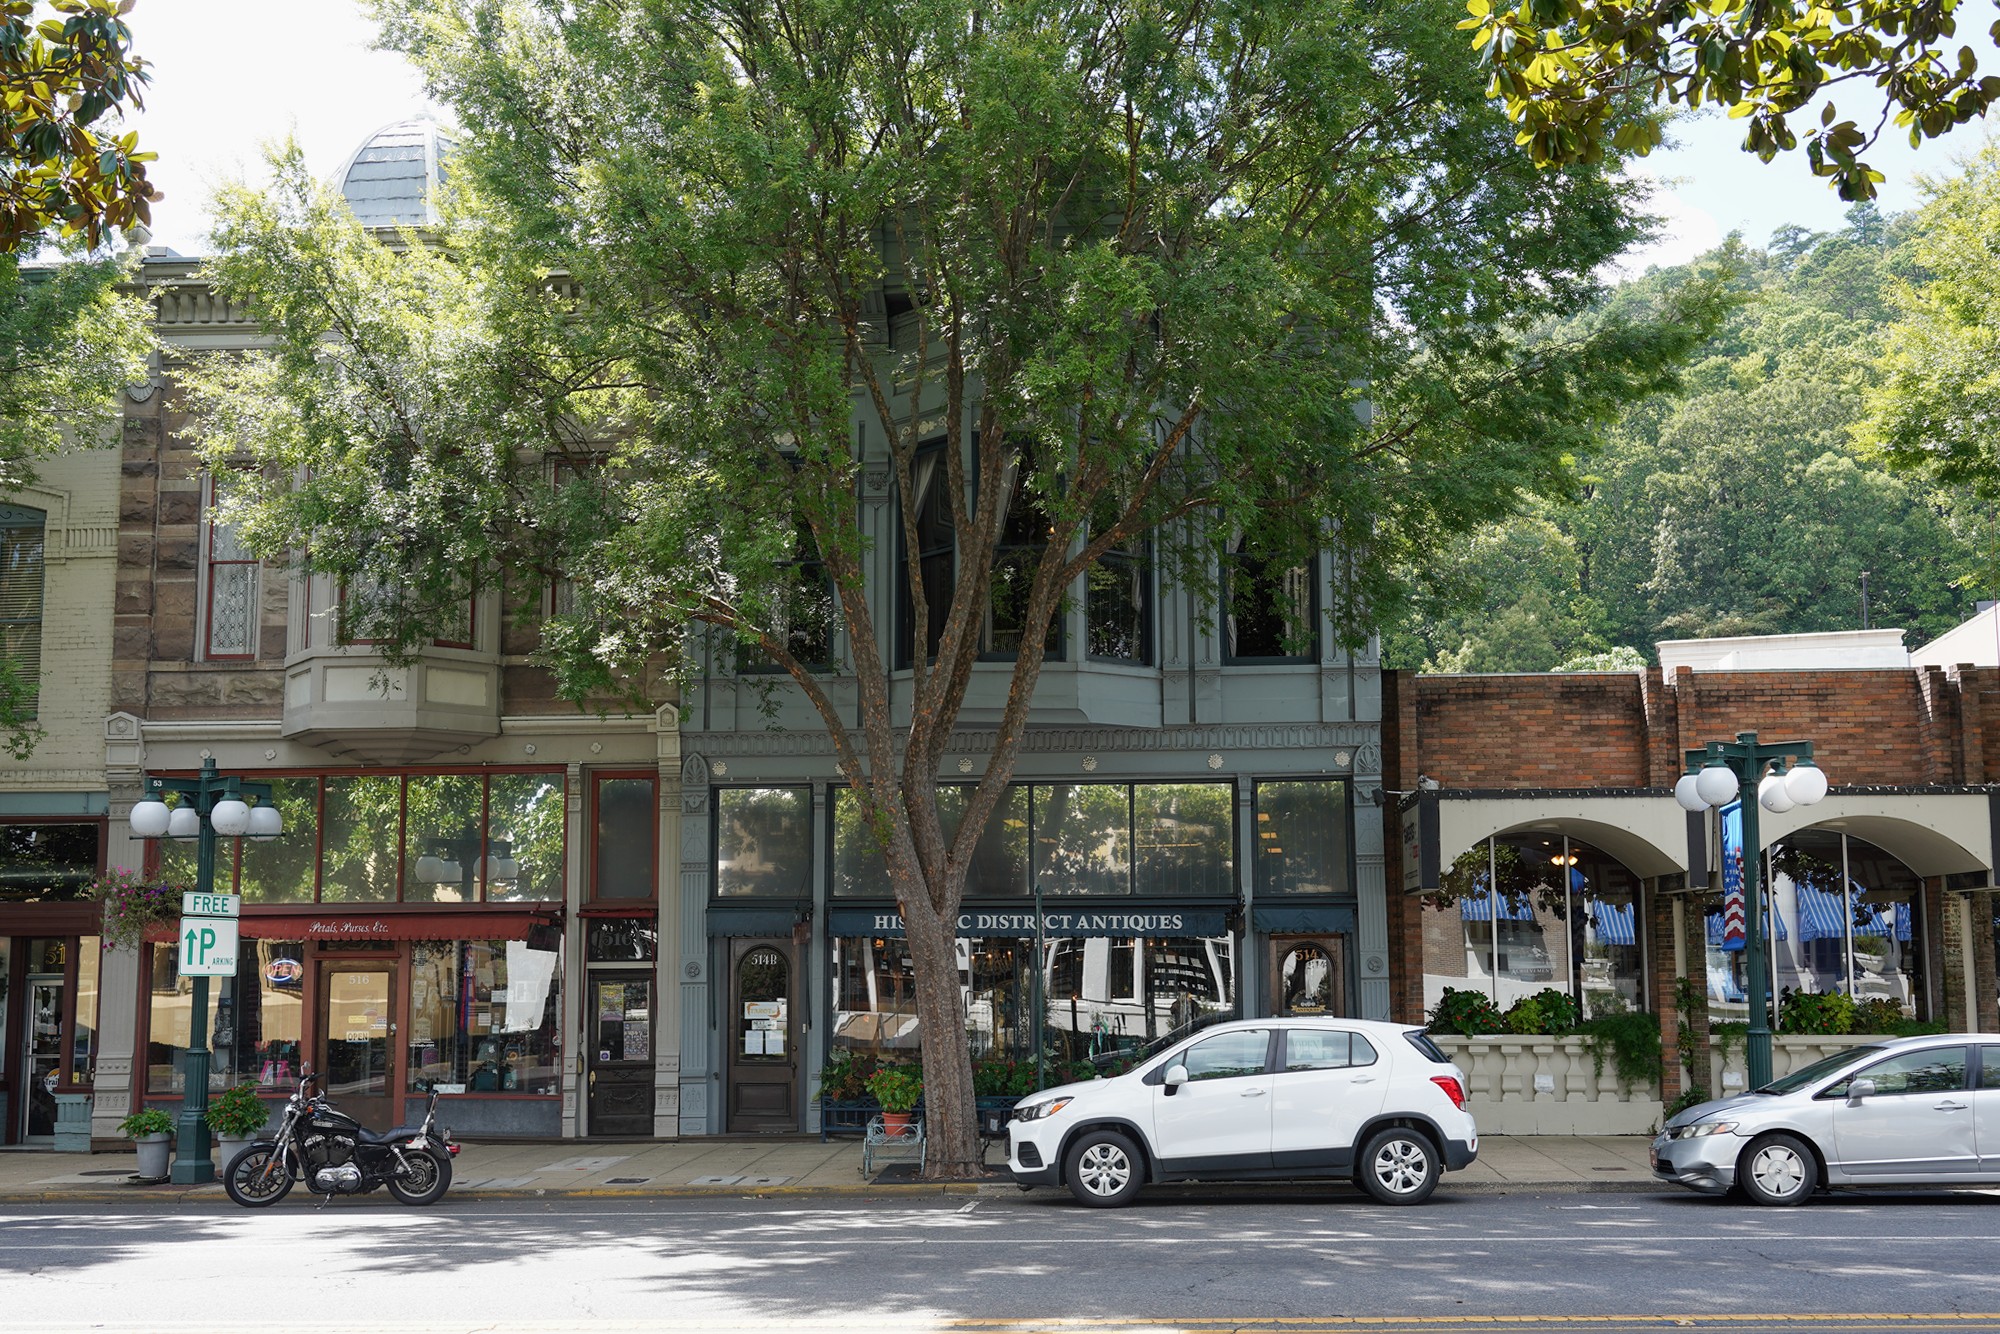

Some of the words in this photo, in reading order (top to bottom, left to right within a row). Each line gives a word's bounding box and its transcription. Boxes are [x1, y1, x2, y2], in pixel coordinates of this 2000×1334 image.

[193, 896, 230, 913] FREE
[372, 920, 389, 933] Etc.
[874, 915, 972, 930] HISC
[977, 914, 1073, 930] DISTRCT
[1075, 915, 1184, 931] ANTIQUES
[602, 932, 633, 946] 516
[199, 928, 216, 966] P
[211, 957, 234, 966] ARKING
[45, 946, 66, 965] 51
[751, 954, 778, 966] 514B
[1295, 949, 1320, 961] 514
[265, 964, 300, 977] OPEN
[348, 975, 370, 985] 516
[347, 1032, 369, 1041] OPEN
